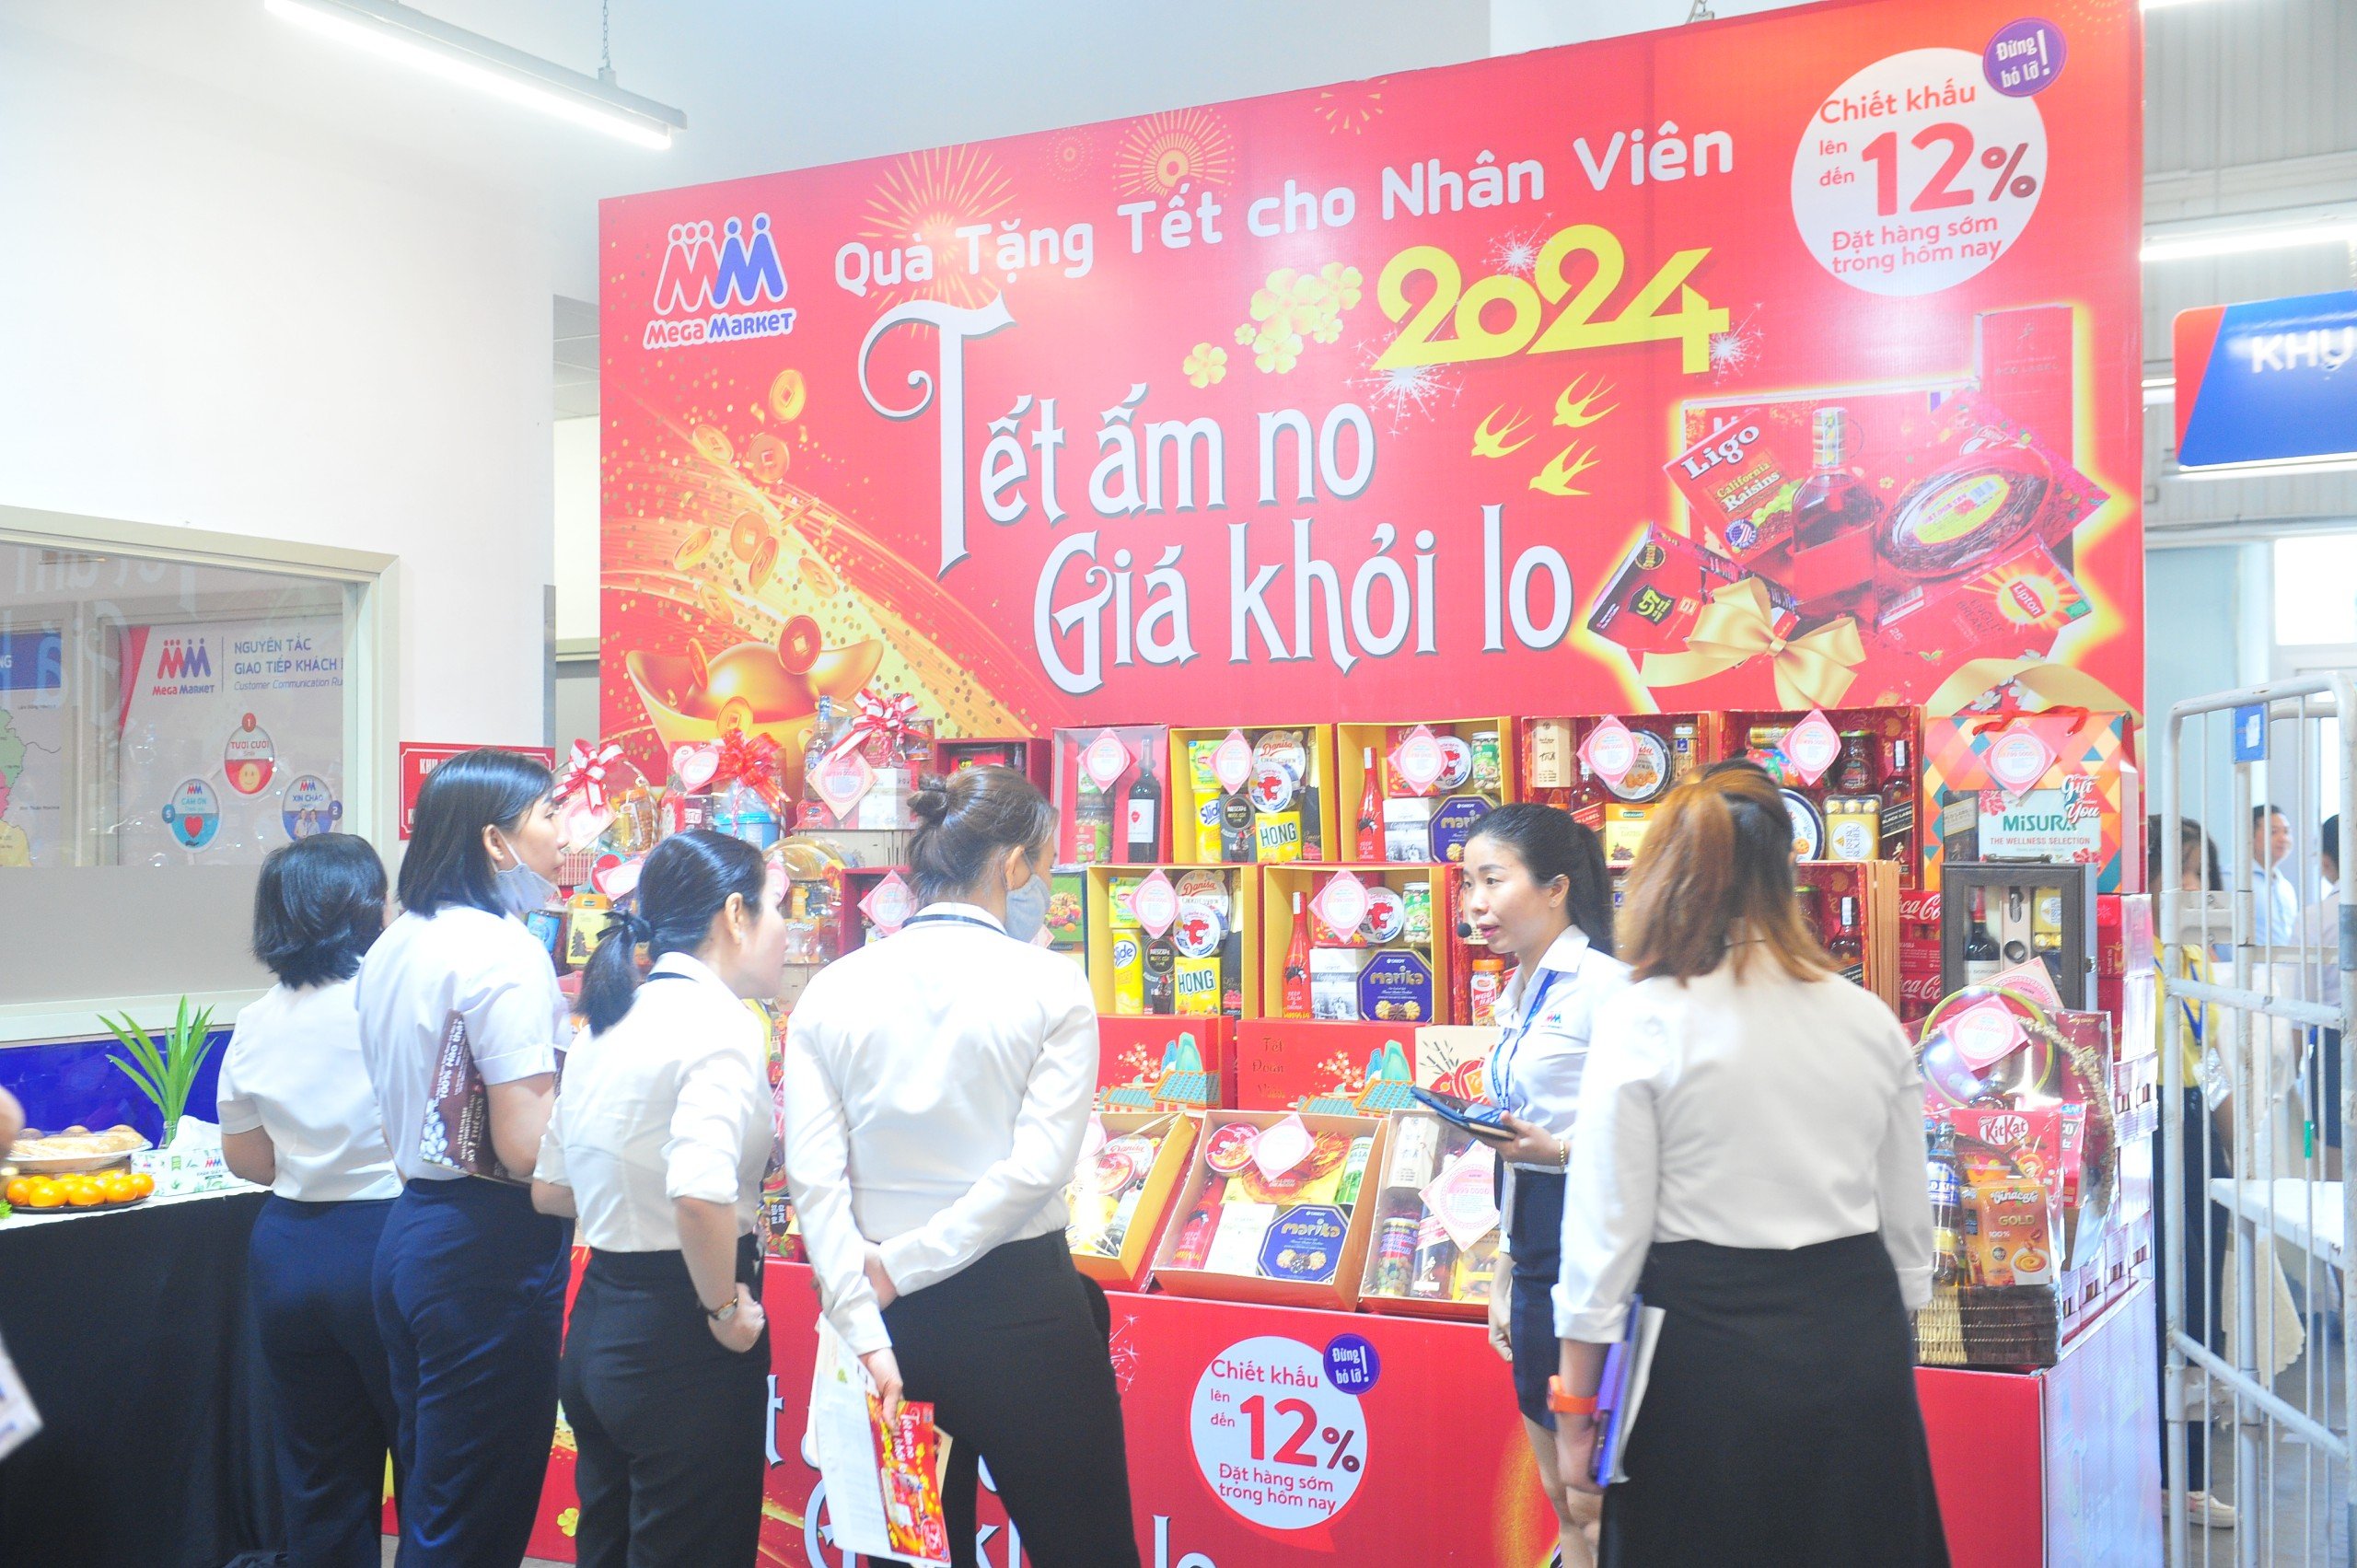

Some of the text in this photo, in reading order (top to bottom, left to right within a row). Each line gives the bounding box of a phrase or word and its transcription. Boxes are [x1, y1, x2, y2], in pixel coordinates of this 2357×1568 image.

[1995, 32, 2038, 63] Đừng
[1819, 76, 1977, 125] Chiết khấu
[1818, 138, 1849, 157] lên
[1818, 166, 1855, 188] đến
[1862, 122, 2038, 217] 12%
[834, 121, 1734, 296] Quà Tặng Tết cho Nhân Viên
[1832, 214, 1999, 255] Đặt hàng sớm
[1832, 239, 2003, 275] trong hôm nay
[1369, 223, 1730, 375] 2024
[857, 291, 1376, 582] Tết ấm no
[1680, 425, 1760, 480] Ligo
[1716, 461, 1771, 498] California
[1721, 470, 1782, 513] Raisins
[1033, 503, 1573, 698] Giá khỏi lo
[2013, 583, 2042, 618] Lipton
[234, 655, 337, 676] GIAO TIẾP KHÁCH
[234, 679, 270, 691] Customer
[273, 679, 330, 691] Communication
[2061, 774, 2096, 801] Gift
[1200, 799, 1221, 822] Slid
[2065, 804, 2101, 824] You
[1991, 837, 2091, 845] THE WELLNESS SELECTION
[1182, 879, 1218, 897] Danisa
[1369, 965, 1424, 986] marika
[1986, 1115, 2027, 1144] KitKat
[1281, 1217, 1341, 1238] marika
[1997, 1214, 2037, 1226] GOLD
[1331, 1347, 1361, 1365] Đừng
[1211, 1359, 1319, 1388] Chiết khấu
[1210, 1388, 1230, 1402] lên
[1210, 1412, 1236, 1428] đến
[1239, 1394, 1361, 1473] 12%
[1219, 1462, 1334, 1493] Đặt hàng sớm
[1219, 1482, 1337, 1516] trong hôm nay
